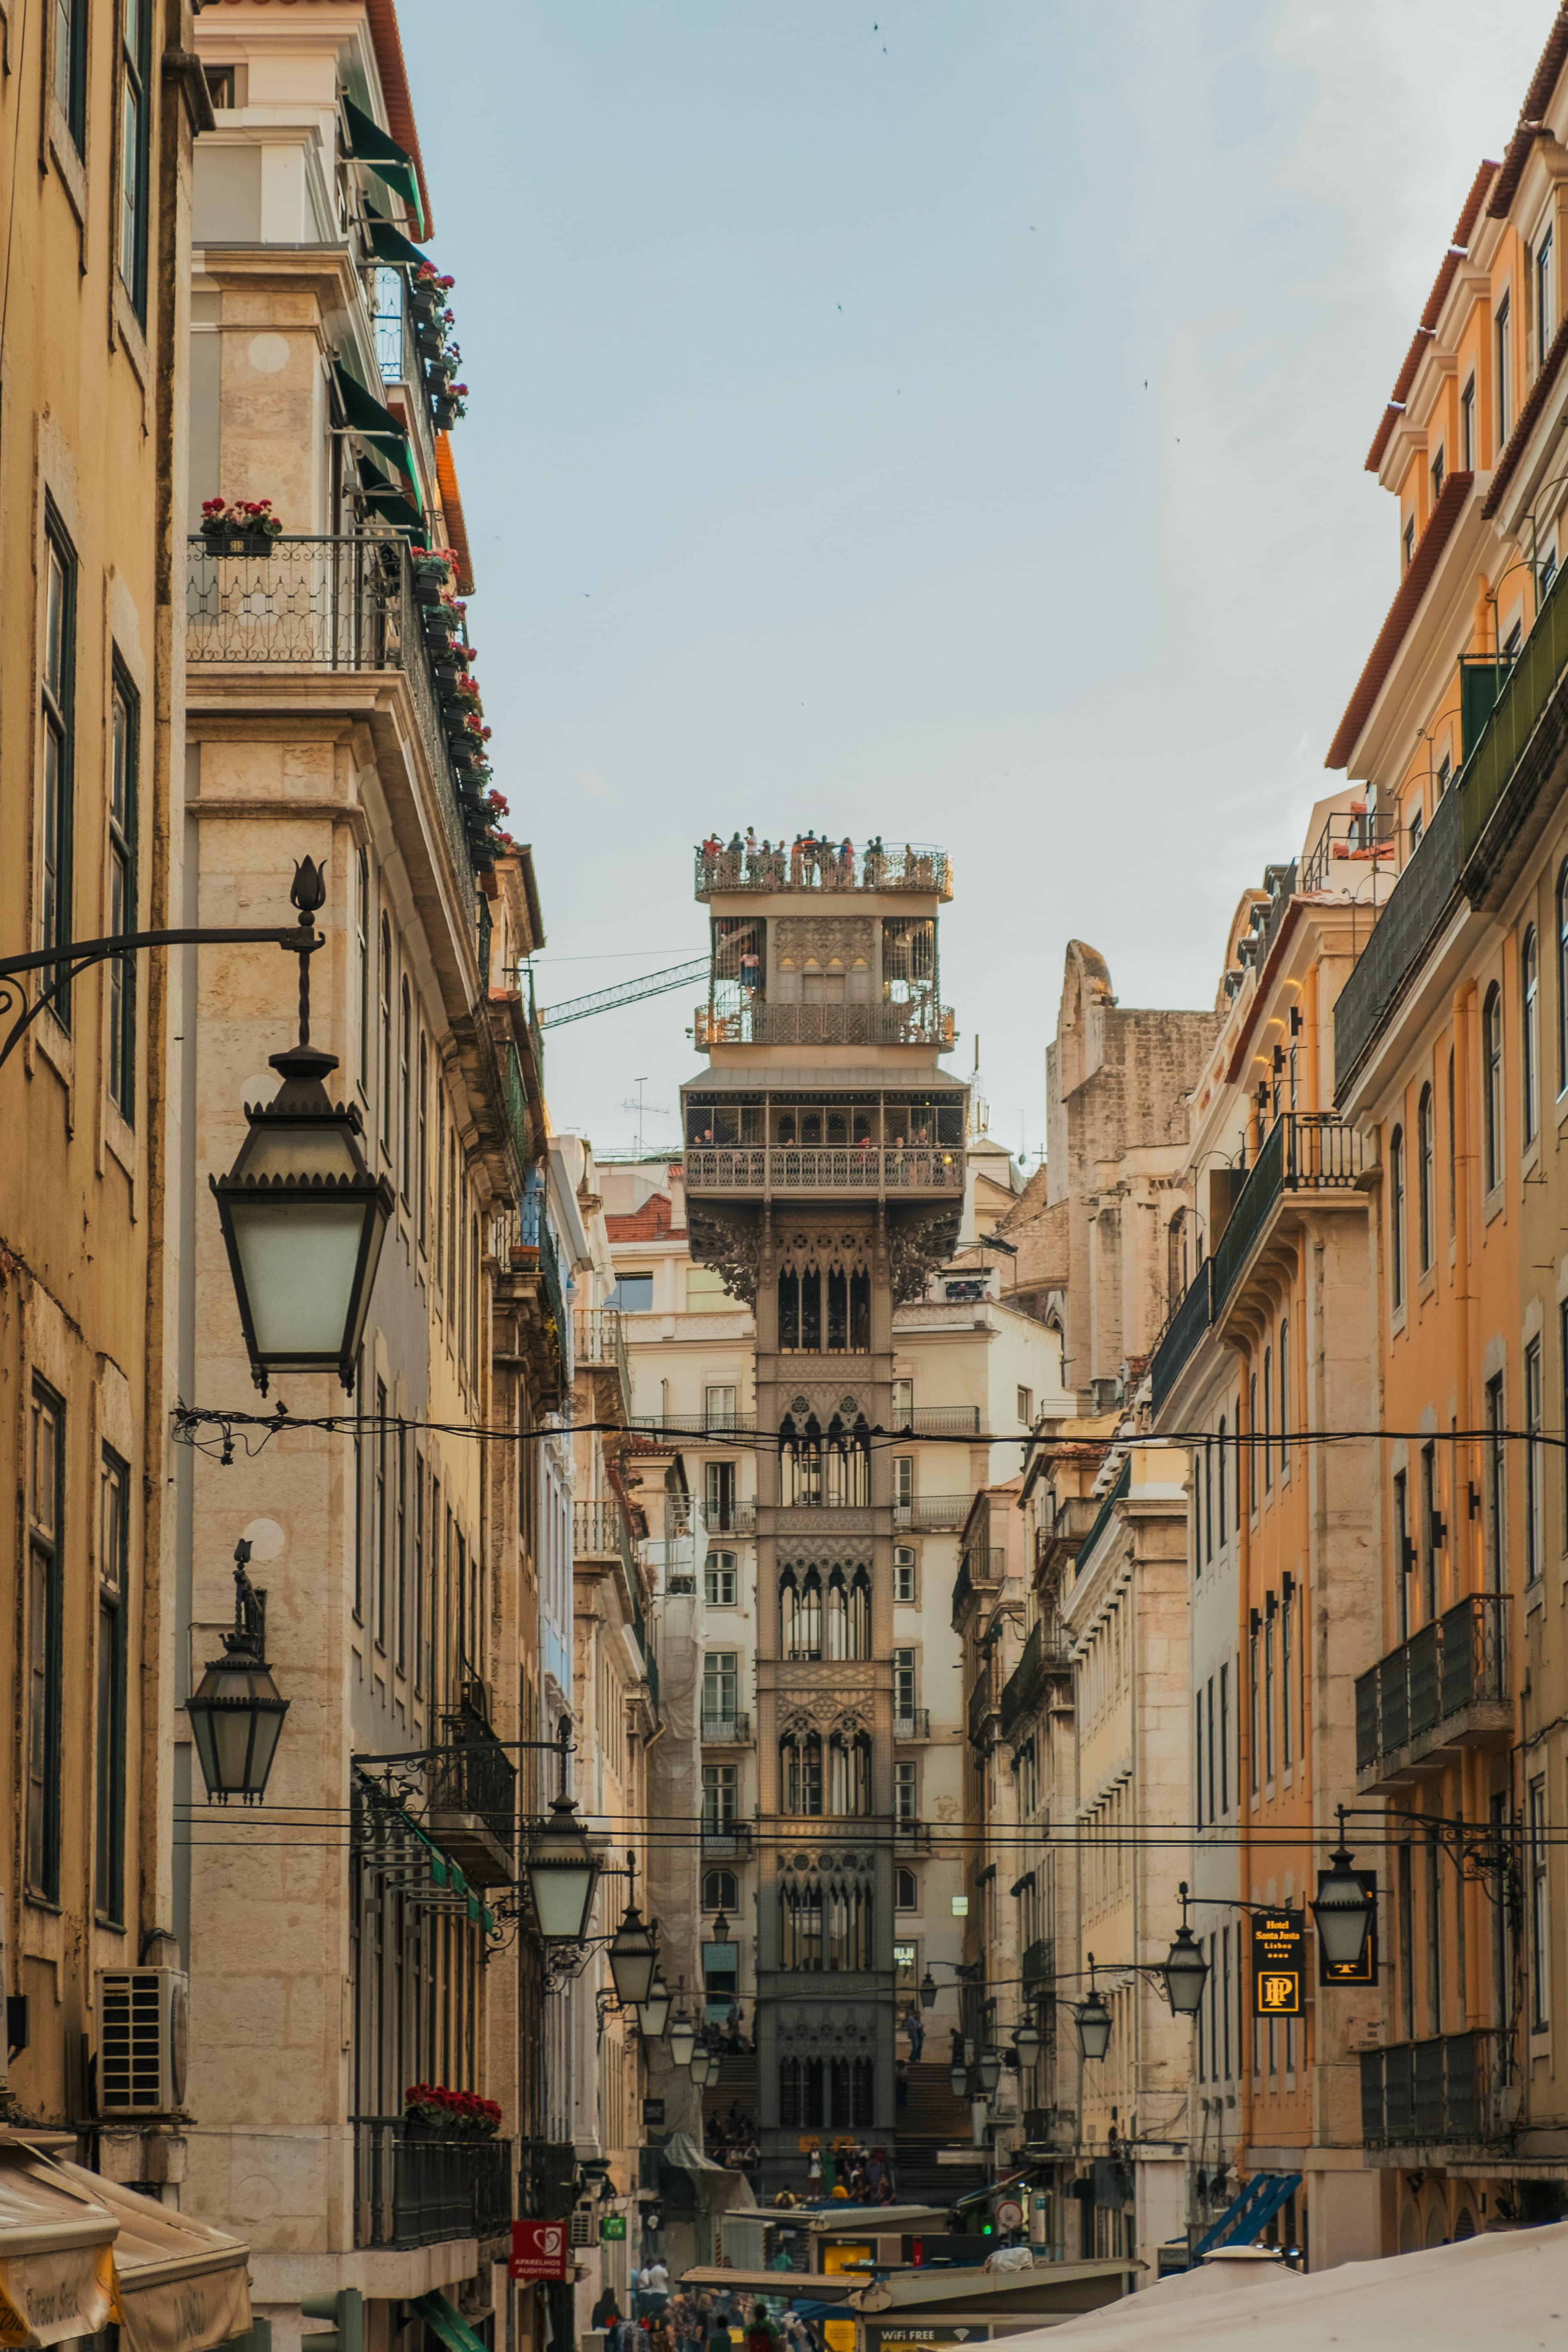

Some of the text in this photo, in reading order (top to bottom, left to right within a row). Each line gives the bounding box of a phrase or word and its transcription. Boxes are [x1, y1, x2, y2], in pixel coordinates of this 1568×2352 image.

[1267, 1920, 1289, 1929] Hotel
[1256, 1931, 1300, 1940] Santa Justa
[881, 2330, 934, 2340] WiFi FREE
